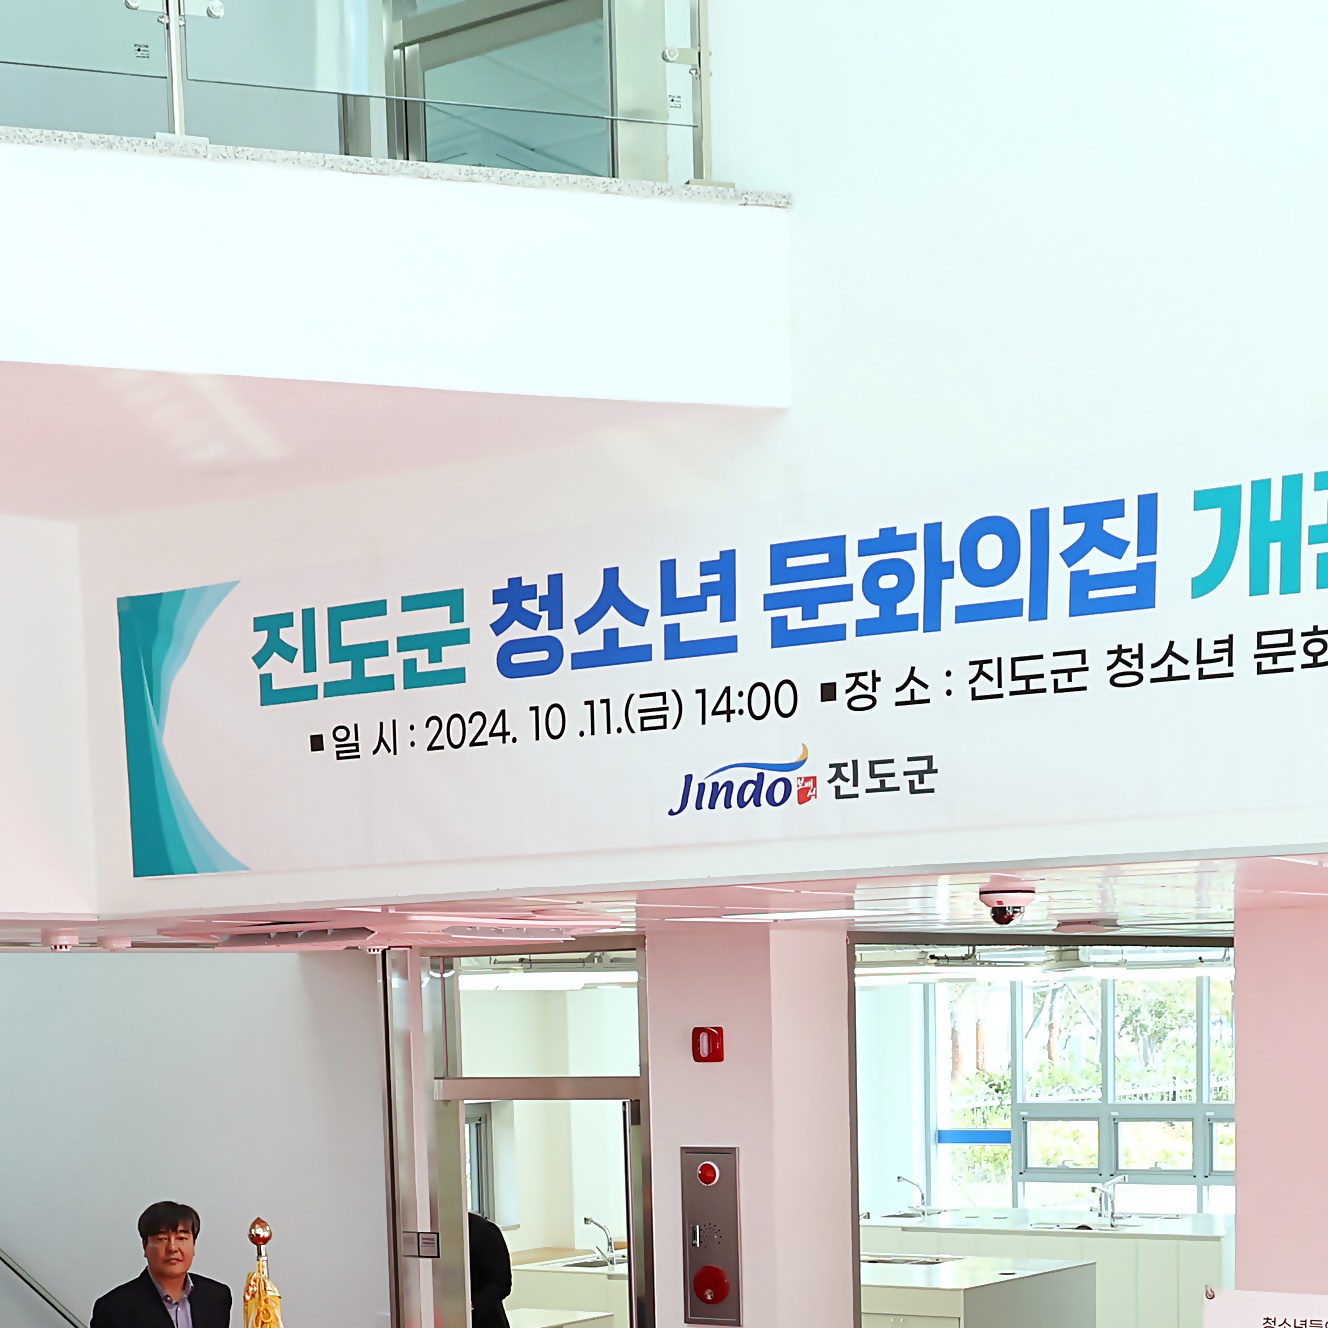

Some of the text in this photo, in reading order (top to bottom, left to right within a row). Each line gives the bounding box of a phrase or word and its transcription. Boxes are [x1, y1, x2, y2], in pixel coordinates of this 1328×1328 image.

[251, 587, 472, 707] 진도군
[489, 549, 739, 680] 청소년
[762, 491, 1159, 650] 문화의집
[424, 710, 519, 752] 2024.
[695, 677, 799, 726] 14:00
[967, 649, 1090, 702] 진도군
[1106, 632, 1237, 690] 청소년
[667, 771, 793, 817] Jindo
[826, 754, 939, 800] 진도군
